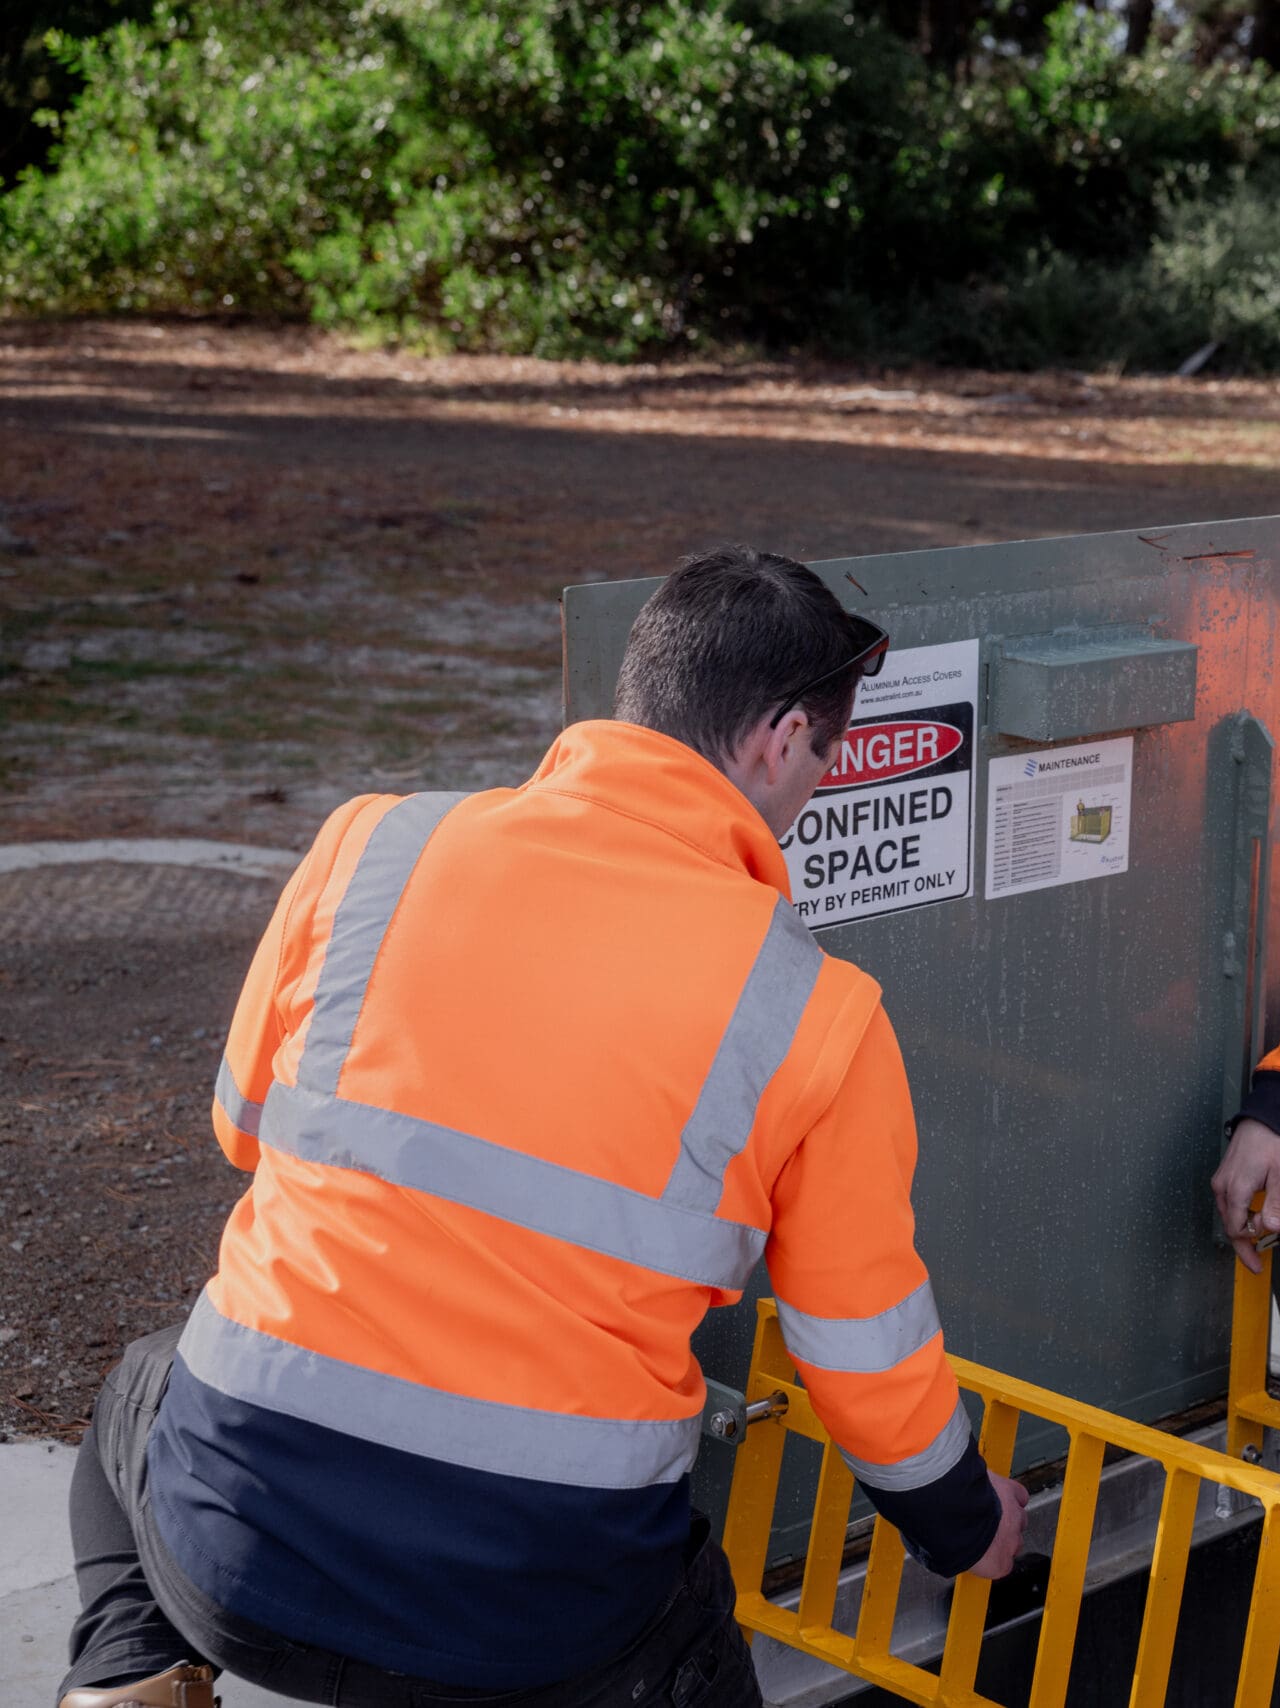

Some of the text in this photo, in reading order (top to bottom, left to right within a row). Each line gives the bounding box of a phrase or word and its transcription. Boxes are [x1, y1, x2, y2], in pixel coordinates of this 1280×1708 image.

[861, 670, 962, 692] ALUMINIUM ACCESS COVERS
[828, 727, 939, 777] NGER
[1038, 753, 1101, 772] MAINTENANCE
[803, 835, 921, 889] SPACE
[825, 893, 847, 912] BY
[851, 880, 910, 906] PERMIT
[915, 870, 956, 892] ONLY
